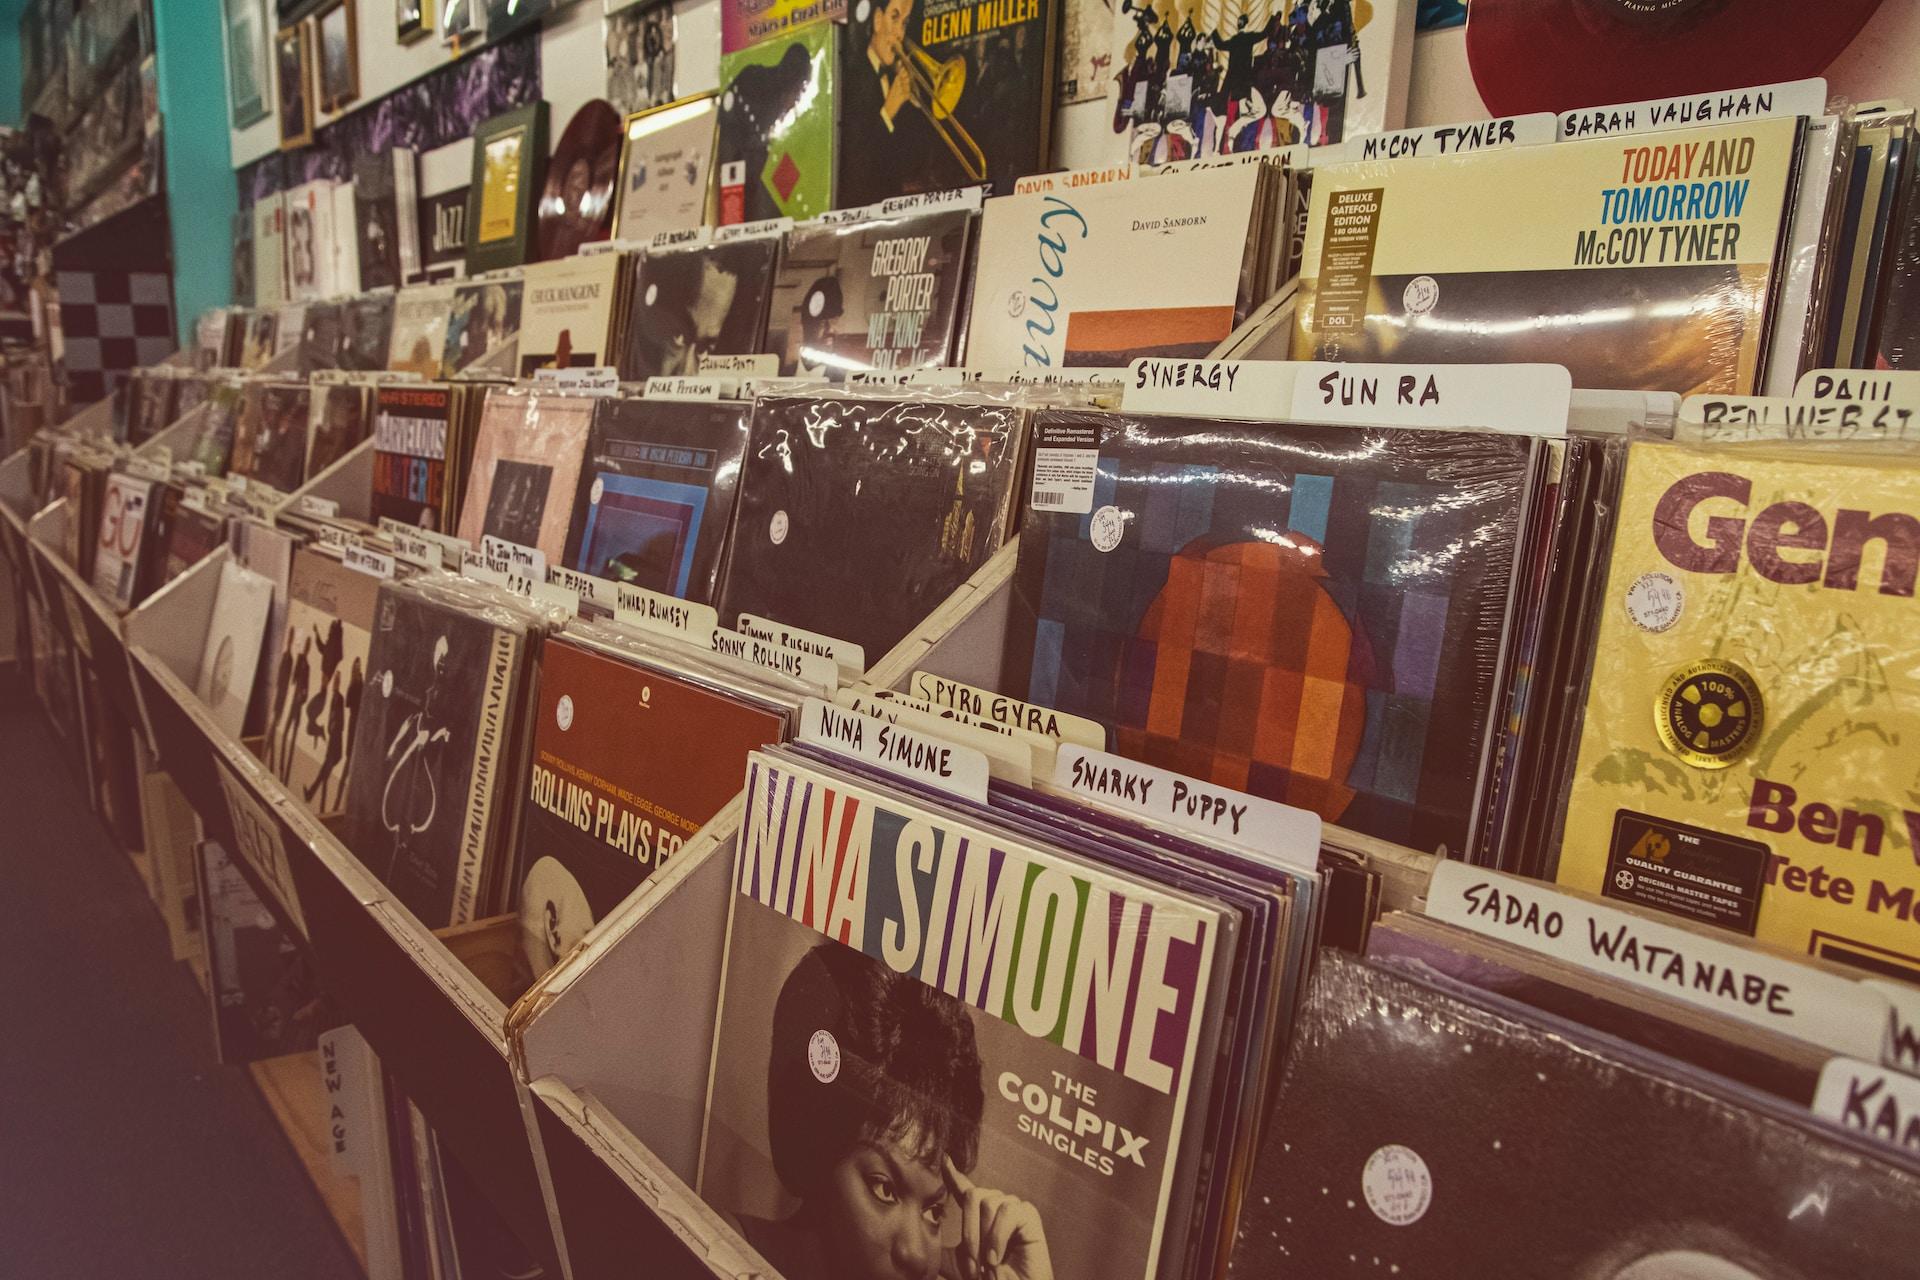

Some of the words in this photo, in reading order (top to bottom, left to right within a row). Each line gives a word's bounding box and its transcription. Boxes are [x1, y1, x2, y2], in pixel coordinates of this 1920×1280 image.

[922, 8, 972, 47] GLENN
[977, 0, 1039, 32] MILLER
[1623, 0, 1657, 12] PLAYING
[1564, 109, 1636, 137] SARAH
[1650, 92, 1774, 124] VAUGHAN
[1434, 119, 1516, 154] TYNER
[1622, 142, 1703, 184] TODAY
[1699, 136, 1756, 178] AND
[882, 198, 922, 214] GREGORY
[923, 189, 964, 205] PORTER
[1331, 203, 1378, 216] GATEFOLD
[1338, 193, 1374, 204] DELUXE
[1600, 179, 1750, 225] TOMORROW
[1333, 215, 1371, 226] EDITION
[1347, 226, 1368, 235] GRAM
[871, 236, 932, 278] GREGORY
[1574, 227, 1655, 266] McCOY
[1658, 222, 1741, 262] TYNER
[884, 272, 936, 313] PORTER
[866, 312, 892, 349] NAT
[1328, 316, 1346, 325] DOL
[1136, 360, 1240, 392] SYNERGY
[1319, 370, 1378, 406] SUN
[1398, 374, 1440, 407] RA
[1044, 427, 1066, 435] Definitive
[1703, 401, 1769, 442] BEN
[486, 559, 509, 573] PARKER
[545, 564, 562, 586] ART
[565, 573, 595, 599] PEPPER
[617, 587, 646, 617] HOWARD
[649, 598, 689, 631] RUMSEY
[711, 630, 746, 660] SONNY
[752, 641, 802, 677] ROLLINS
[740, 618, 774, 643] JIMMY
[781, 632, 834, 660] RUSHING
[919, 674, 982, 717] SPYRO
[991, 698, 1062, 738] GYRA
[1660, 686, 1673, 721] LICENSED
[1671, 672, 1685, 686] AND
[1687, 664, 1732, 675] AUTHORIZED
[1701, 681, 1735, 700] 100%
[1674, 701, 1693, 739] ANALOG
[1711, 720, 1746, 748] MASTERS
[820, 705, 862, 751] NINA
[878, 725, 953, 777] SIMONE
[531, 763, 593, 833] ROLLINS
[594, 797, 652, 865] PLAYS
[576, 767, 594, 784] KENNY
[617, 787, 635, 803] WADE
[653, 805, 680, 826] GEORGE
[1072, 756, 1154, 805] SNARKY
[1172, 780, 1248, 835] PUPPY
[1747, 778, 1885, 858] Ben
[1678, 833, 1700, 846] THE
[1625, 857, 1671, 875] QUALITY
[1673, 869, 1743, 895] GUARANTEE
[1638, 875, 1675, 891] ORIGINAL
[1676, 885, 1710, 900] MASTER
[1712, 895, 1739, 909] TAPES
[1664, 891, 1685, 901] original
[1764, 854, 1855, 905] Tete
[1647, 893, 1656, 901] the
[1656, 895, 1668, 904] best
[741, 760, 876, 953] NINA
[881, 815, 1203, 1095] SIMONE
[1463, 883, 1564, 938] SADAO
[1588, 917, 1794, 1016] WATANABE
[322, 1040, 342, 1093] NEW
[1051, 1070, 1097, 1107] THE
[330, 1103, 346, 1154] AGE
[997, 1071, 1150, 1168] COLPIX
[1016, 1114, 1114, 1177] SINGLES
